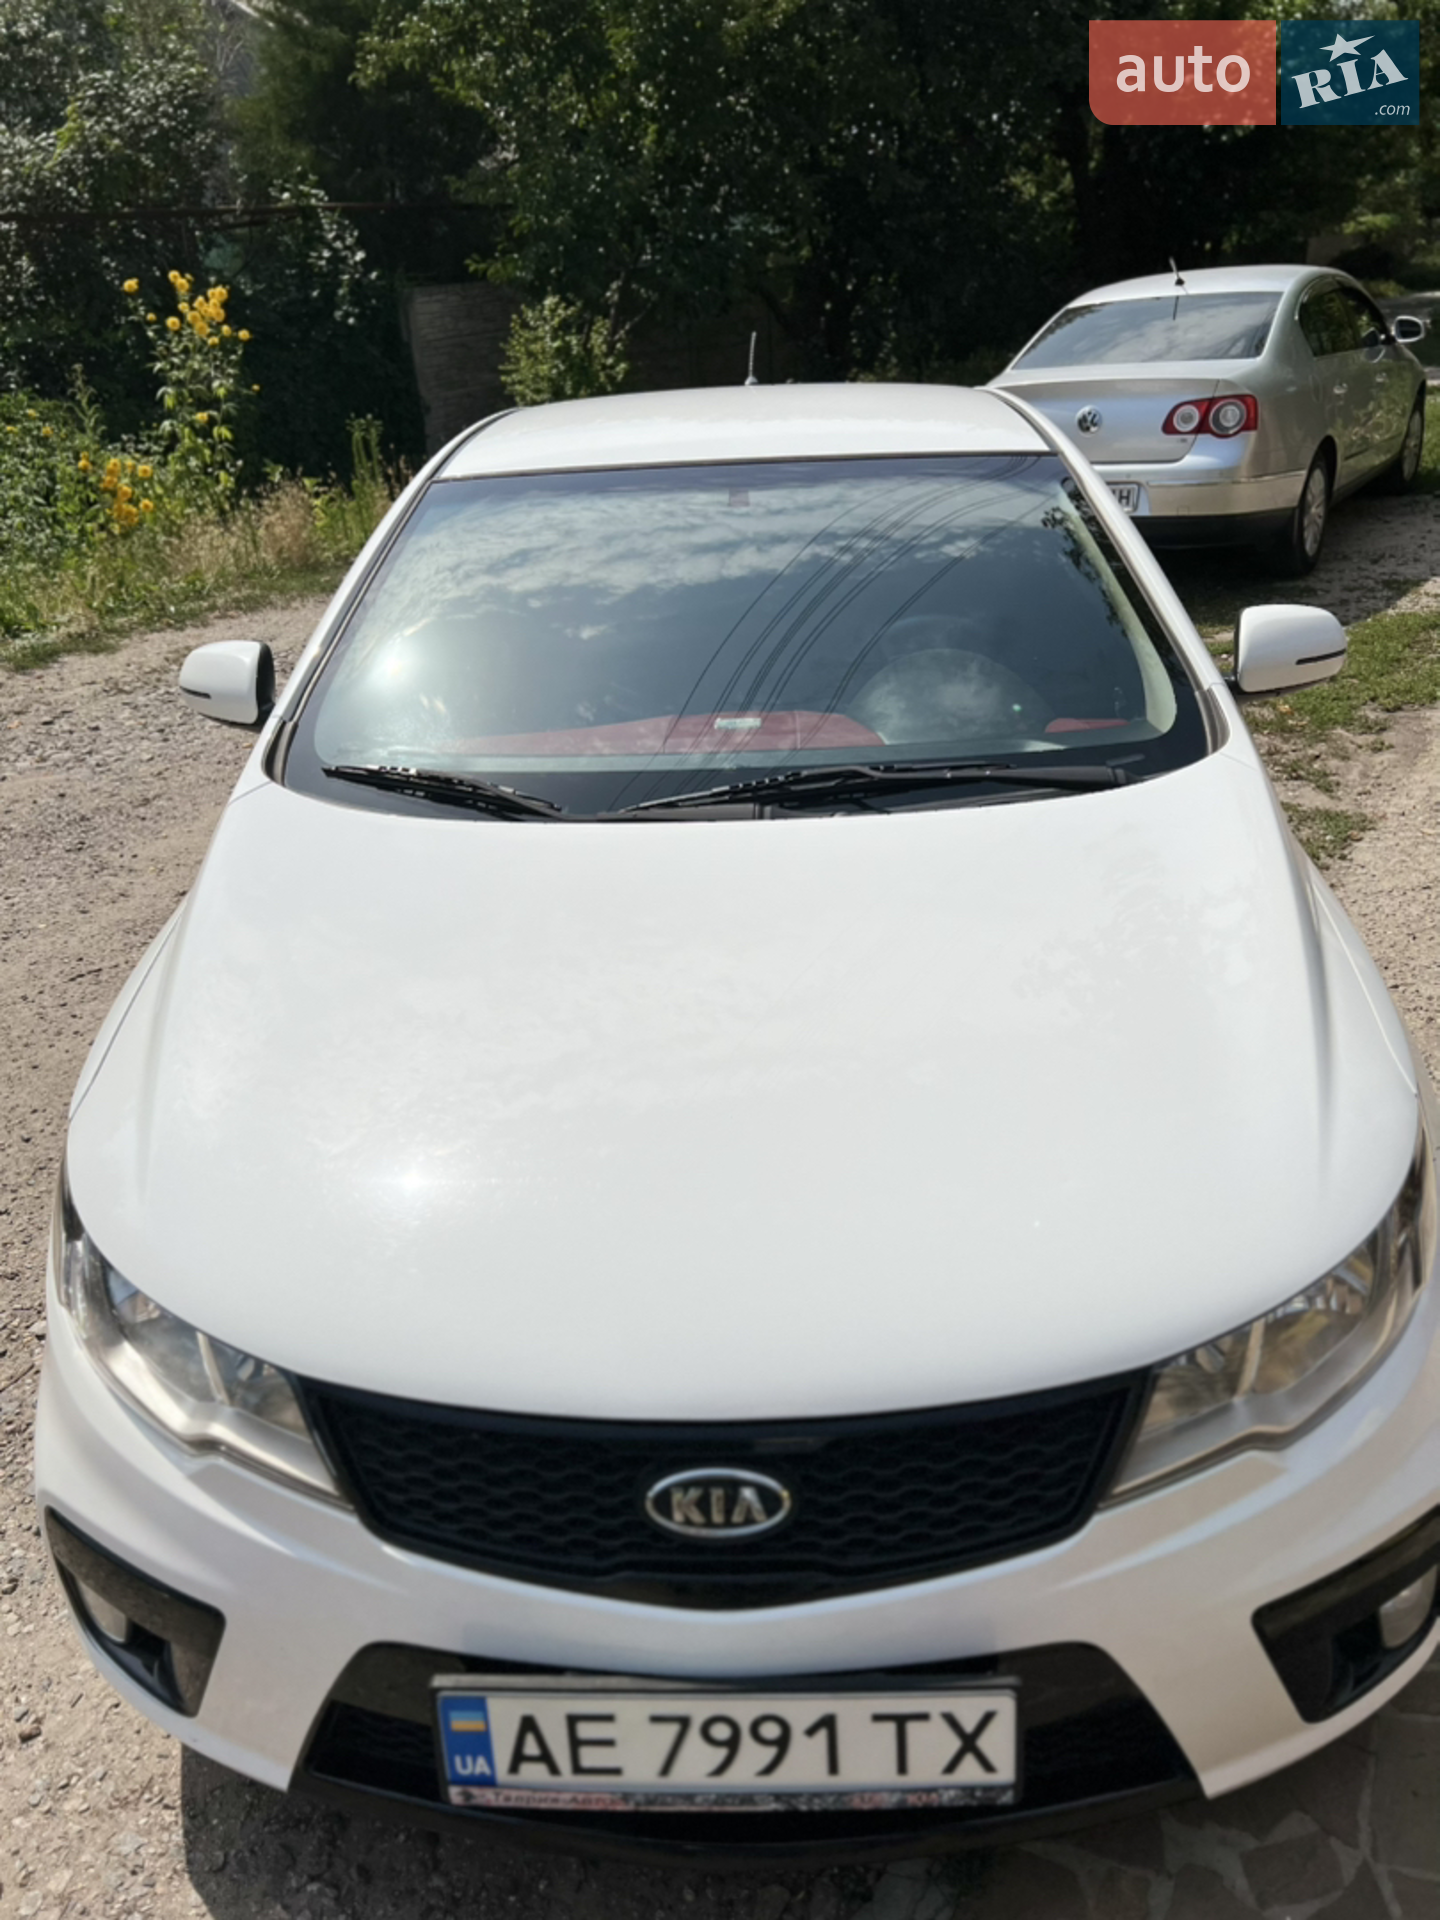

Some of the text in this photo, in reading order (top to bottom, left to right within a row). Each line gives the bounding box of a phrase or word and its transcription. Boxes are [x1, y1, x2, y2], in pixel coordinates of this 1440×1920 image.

[670, 1486, 768, 1525] KIA
[507, 1709, 999, 1778] AE 7991 TX
[454, 1754, 492, 1776] UA
